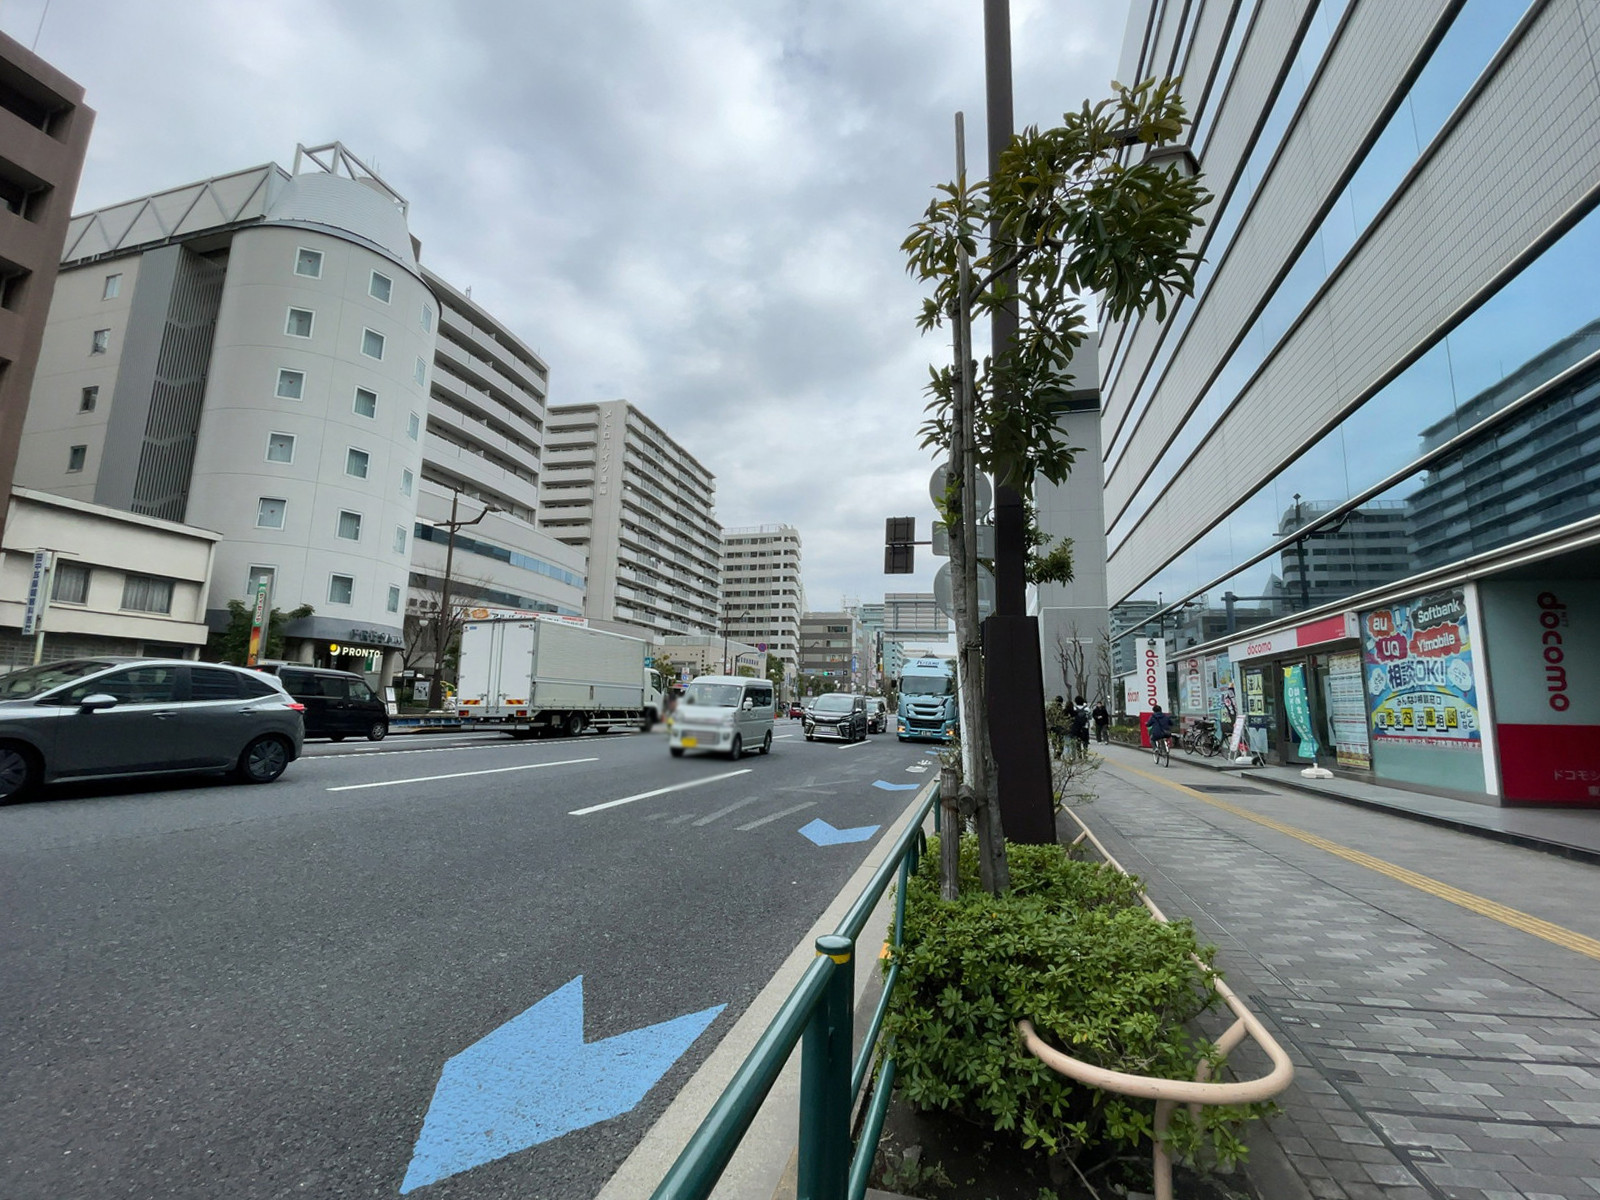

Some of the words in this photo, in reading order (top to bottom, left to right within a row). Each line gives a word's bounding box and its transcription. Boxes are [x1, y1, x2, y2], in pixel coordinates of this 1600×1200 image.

[1373, 617, 1388, 630] au
[1247, 641, 1272, 655] docomo
[1382, 641, 1400, 656] UQ
[1417, 633, 1455, 652] Y!mobile
[341, 646, 381, 658] PRONTO
[1537, 592, 1570, 712] docomo
[1145, 650, 1158, 706] docomo
[1388, 660, 1445, 689] 相談OK!
